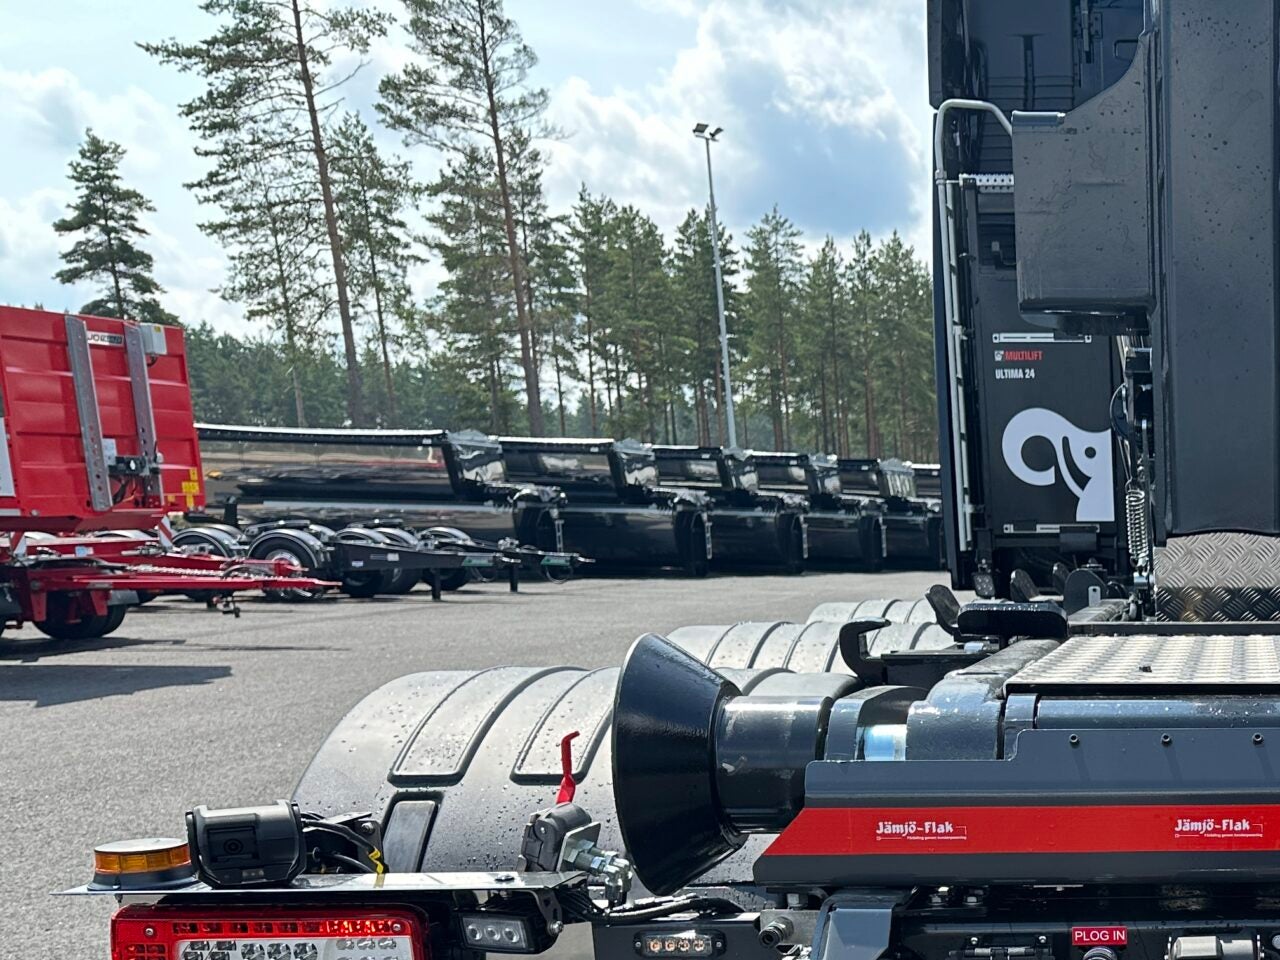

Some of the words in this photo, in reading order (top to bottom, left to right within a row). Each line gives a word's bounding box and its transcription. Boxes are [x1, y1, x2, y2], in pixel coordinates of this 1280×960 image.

[995, 368, 1024, 379] ULTIMA
[1025, 368, 1035, 379] 24
[876, 821, 954, 837] Jämjö-Flak
[1174, 818, 1250, 834] Jämjö-Flak
[1075, 930, 1109, 941] PLOG
[1113, 930, 1125, 941] IN
